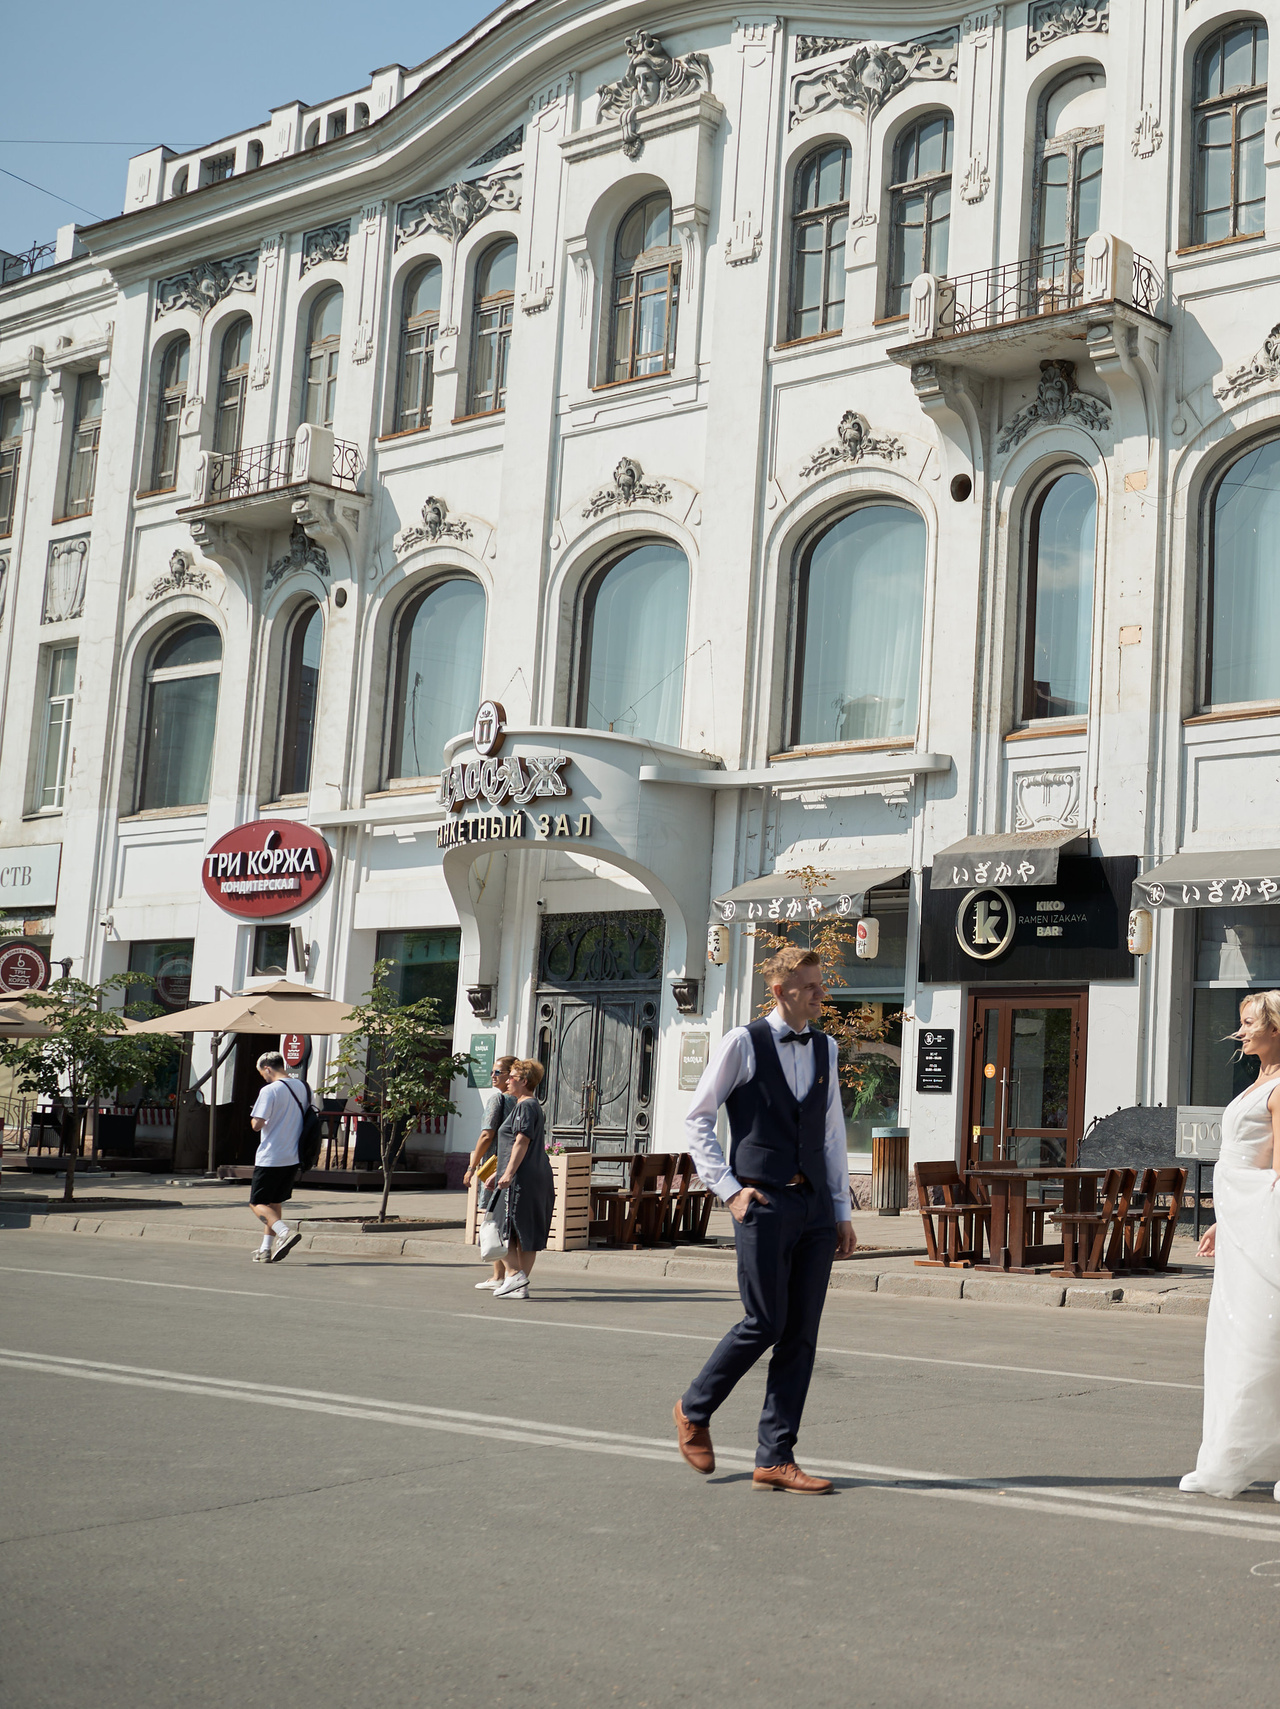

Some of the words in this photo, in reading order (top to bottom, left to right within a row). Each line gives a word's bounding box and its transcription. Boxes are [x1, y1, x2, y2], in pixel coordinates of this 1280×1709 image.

[436, 809, 523, 848] АНКЕТНЫЙ
[538, 813, 592, 838] ЗАЛ
[206, 851, 242, 878] ТРИ
[247, 846, 316, 876] КОРЖА
[952, 860, 1036, 885] いざかや
[220, 878, 297, 894] КОНДИТЕРСКАЯ
[1182, 878, 1278, 904] いざかや
[748, 897, 823, 920] いざかや
[1036, 901, 1064, 912] KIKO
[1018, 915, 1049, 924] RAMEN
[1051, 914, 1088, 923] IZAKAYA
[1036, 926, 1063, 937] BAR
[1179, 1122, 1222, 1155] HOO
